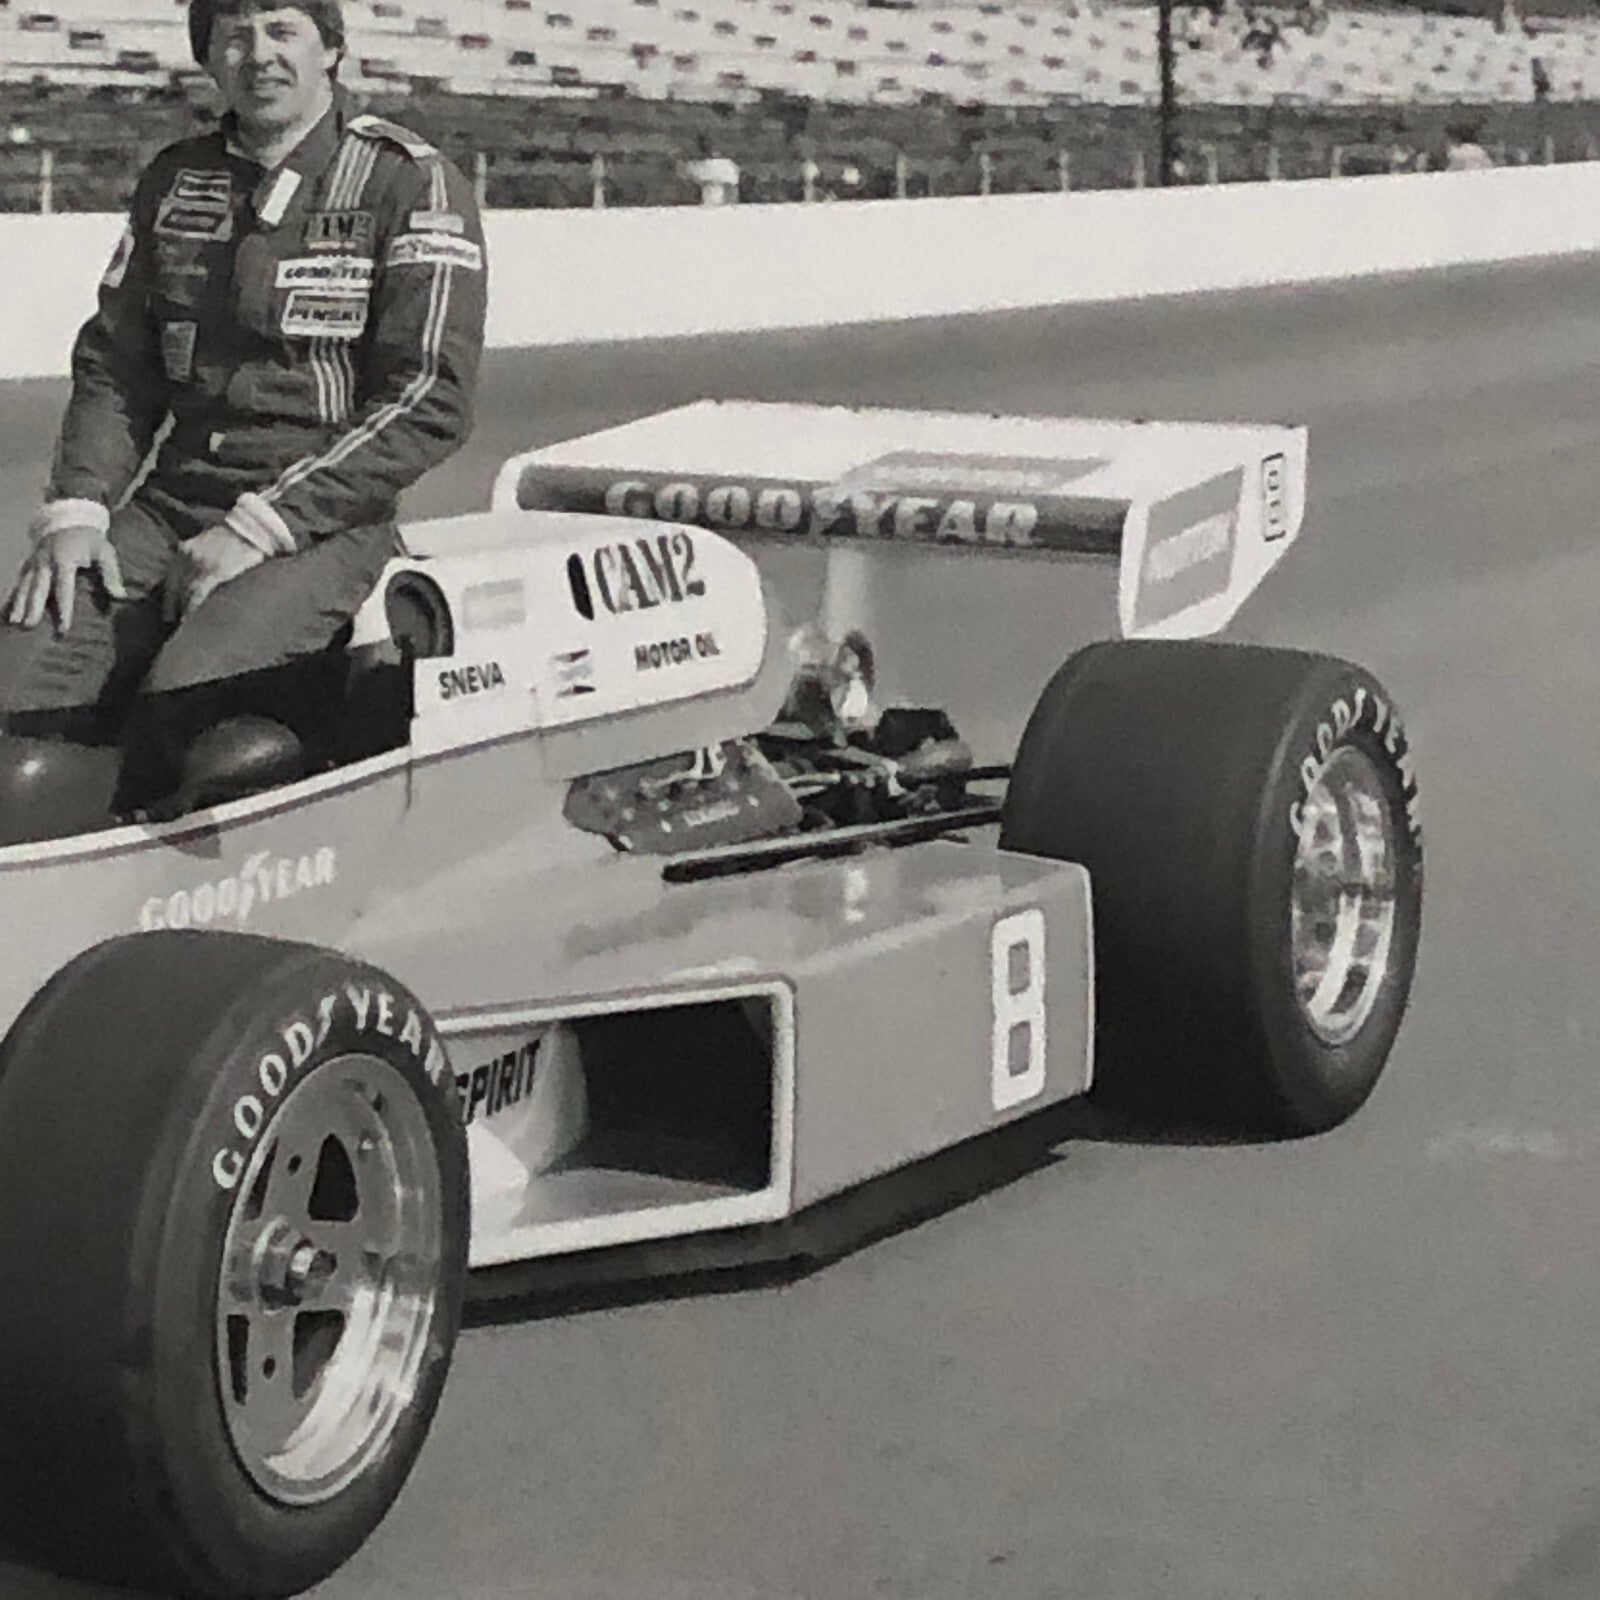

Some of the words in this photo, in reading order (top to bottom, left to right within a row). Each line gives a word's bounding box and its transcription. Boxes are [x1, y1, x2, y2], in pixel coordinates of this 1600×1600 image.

[594, 533, 706, 615] CAM2
[438, 661, 506, 700] SNEVA
[635, 637, 693, 670] MOTOR
[140, 847, 336, 932] GOODYEAR
[992, 908, 1047, 1111] 8
[212, 986, 446, 1190] GOODYEAR
